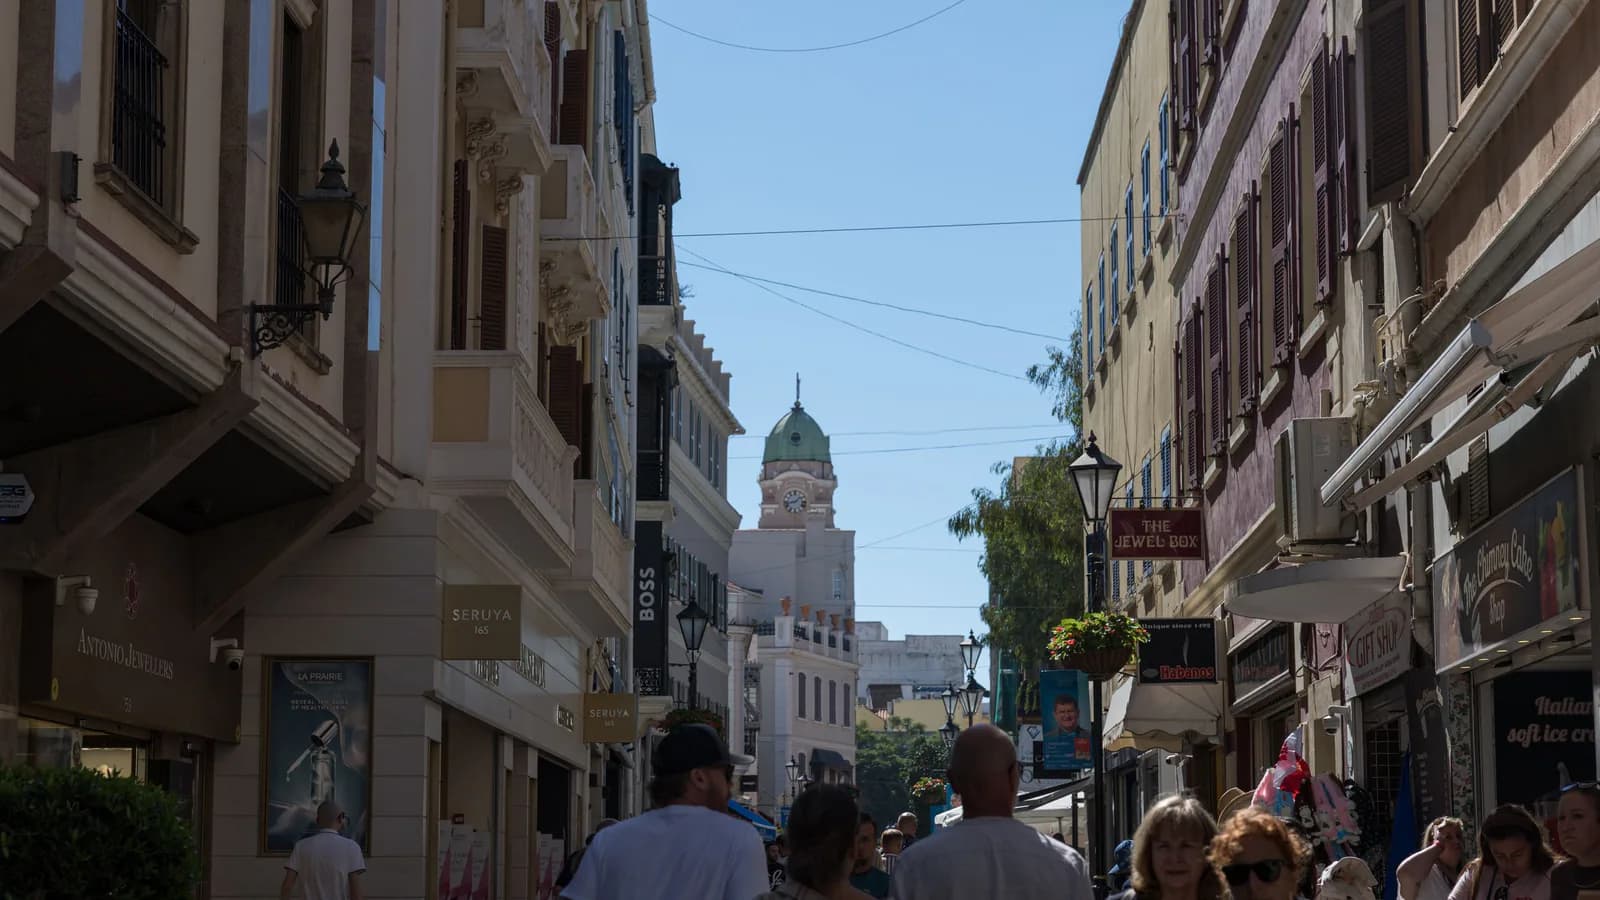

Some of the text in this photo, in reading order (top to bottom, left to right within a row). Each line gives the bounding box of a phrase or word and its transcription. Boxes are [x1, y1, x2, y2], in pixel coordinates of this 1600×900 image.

[1141, 519, 1171, 533] THE
[1114, 535, 1199, 549] JEWEL BOX
[1464, 528, 1534, 616] The Chimney Cake
[639, 567, 656, 622] BOSS
[451, 608, 513, 622] SERUYA
[1489, 592, 1506, 633] Shop
[474, 625, 490, 636] 165
[1355, 630, 1375, 668] GIFT
[1376, 616, 1399, 659] SHOP
[77, 626, 175, 681] ANTONIO JEWELLERS
[297, 672, 344, 682] LA PRAIRIE
[1159, 664, 1215, 681] Habanos
[589, 706, 631, 719] SERUYA
[1506, 722, 1541, 748] soft
[1543, 723, 1569, 743] ice
